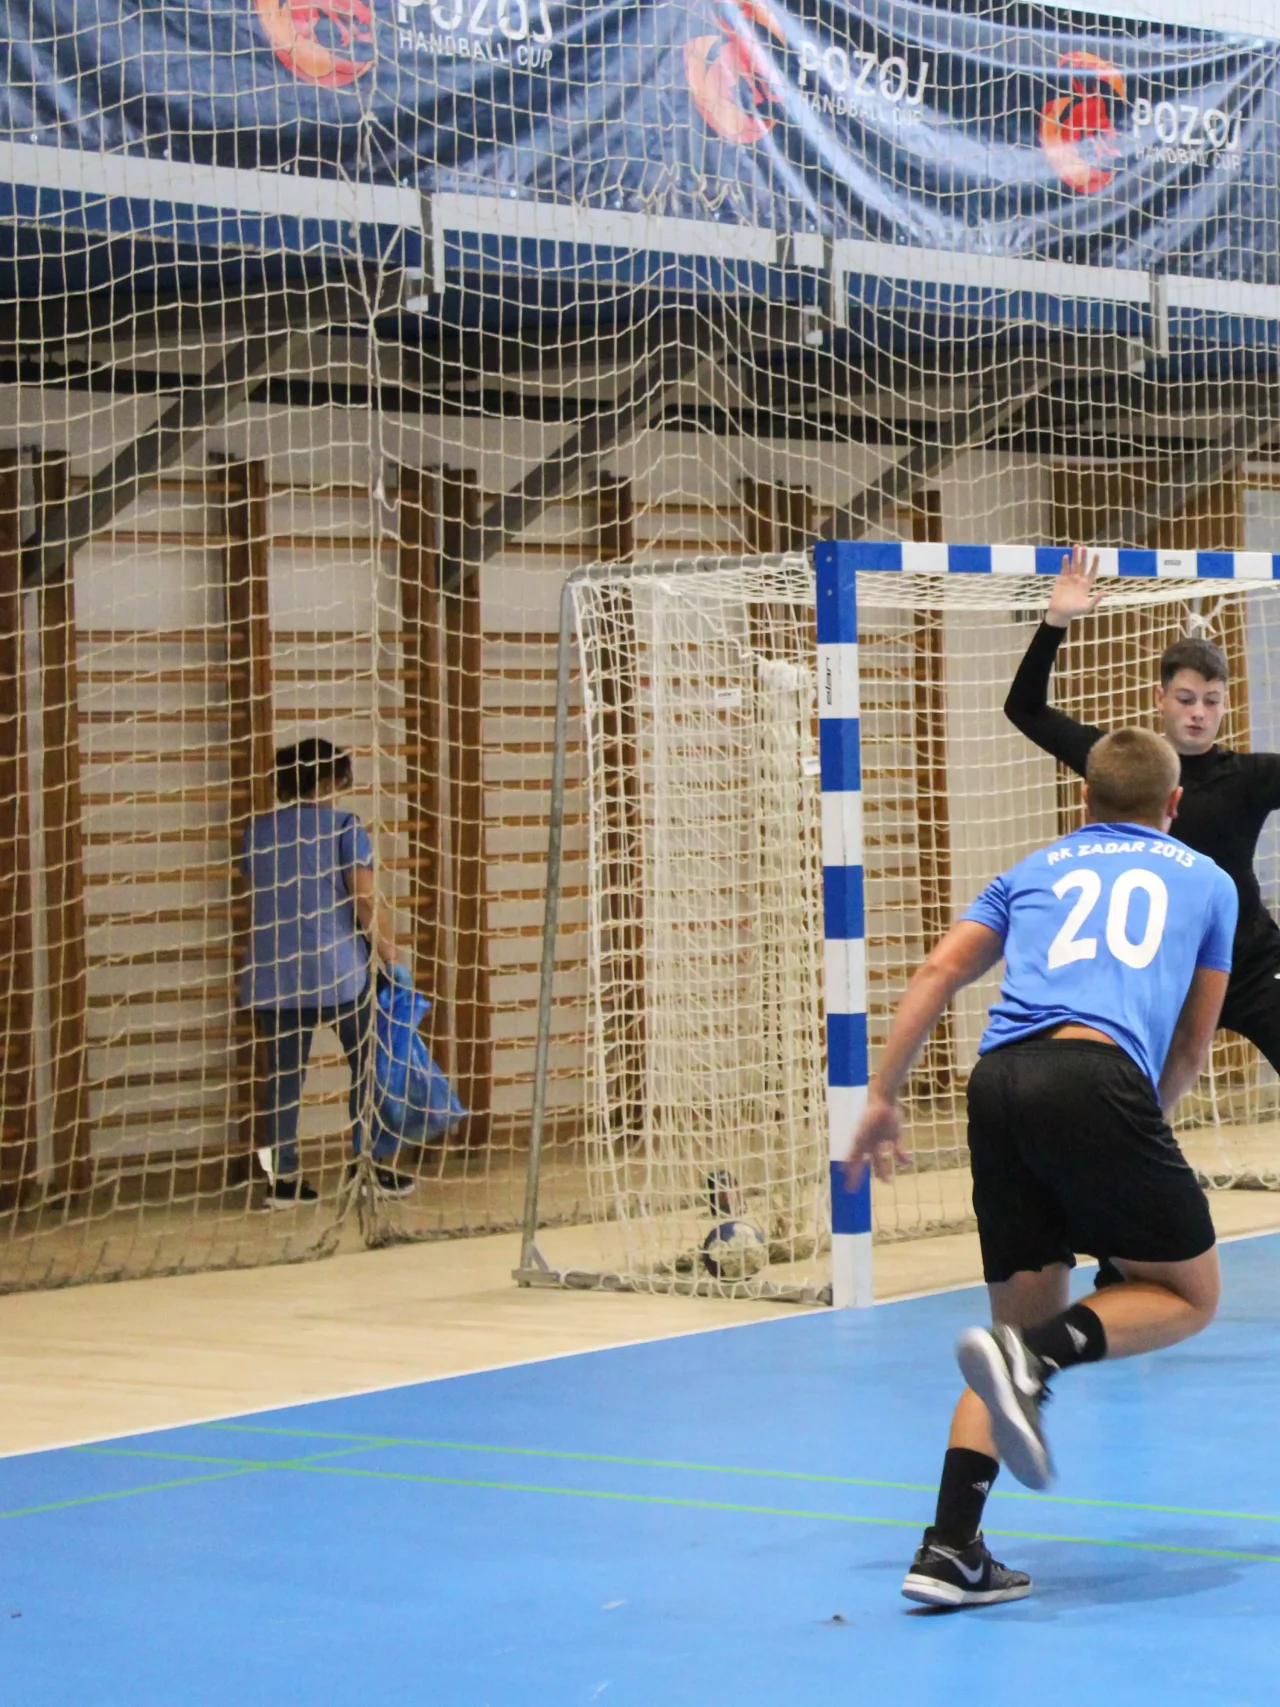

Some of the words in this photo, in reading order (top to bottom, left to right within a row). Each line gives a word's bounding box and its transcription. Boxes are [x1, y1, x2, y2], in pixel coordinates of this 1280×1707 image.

[399, 29, 511, 63] HANDBALL
[516, 44, 553, 69] CUP
[798, 40, 929, 105] POZOJ
[1132, 97, 1242, 150] POZOJ
[1047, 847, 1074, 866] RK
[1077, 841, 1147, 857] ZADAR
[1149, 841, 1197, 868] 2013
[1047, 868, 1169, 970] 20
